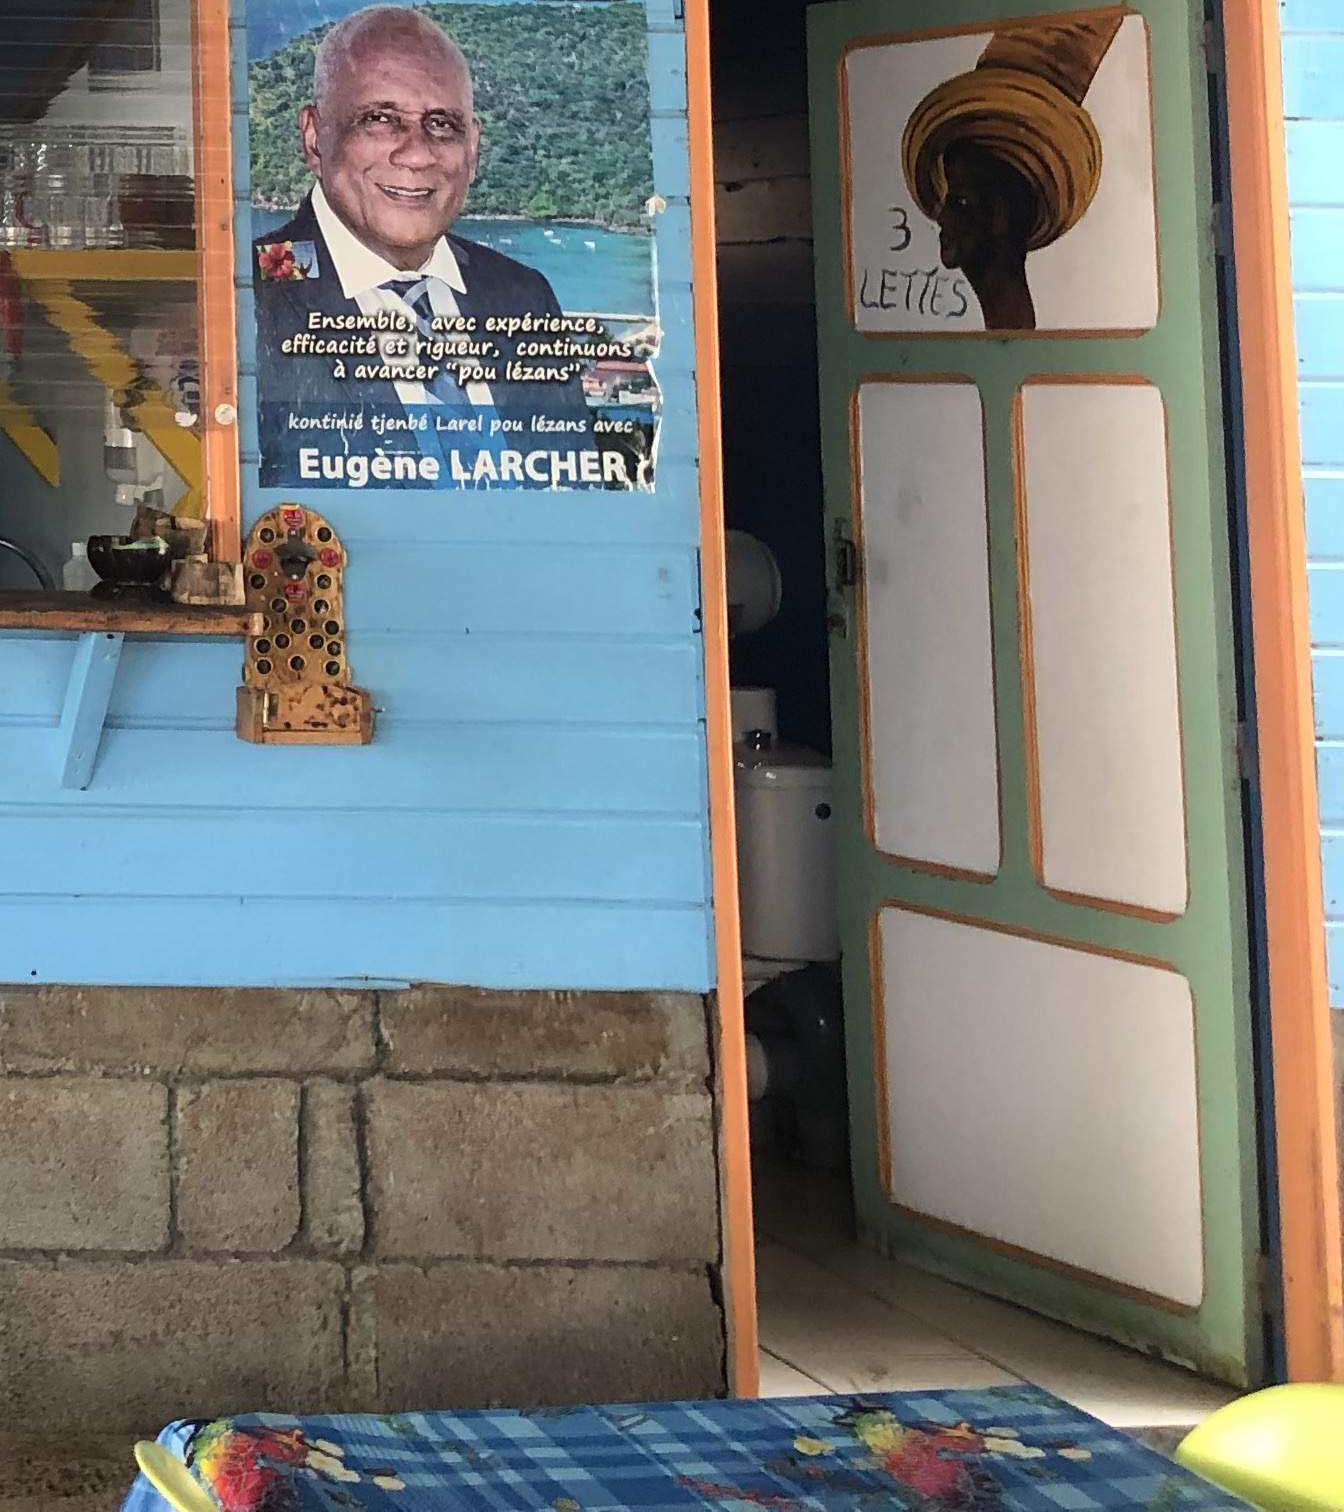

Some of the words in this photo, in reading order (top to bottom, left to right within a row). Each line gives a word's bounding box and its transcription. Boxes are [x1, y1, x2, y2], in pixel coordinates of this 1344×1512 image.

[886, 206, 912, 252] 3
[860, 267, 968, 317] LETTES
[307, 311, 416, 333] Ensemble,
[430, 317, 477, 332] avec
[485, 314, 605, 339] expérience,
[281, 335, 378, 358] efficacité
[385, 339, 407, 356] et
[415, 340, 500, 361] rigueur,
[516, 340, 632, 359] continuons
[333, 359, 347, 378] à
[354, 364, 439, 380] avancer
[370, 414, 428, 436] tjenbé
[435, 415, 483, 433] Larel
[489, 418, 524, 437] pou
[531, 415, 587, 433] lézans
[593, 420, 633, 433] avec
[298, 447, 440, 487] Eugène
[450, 449, 629, 483] LARCHER
